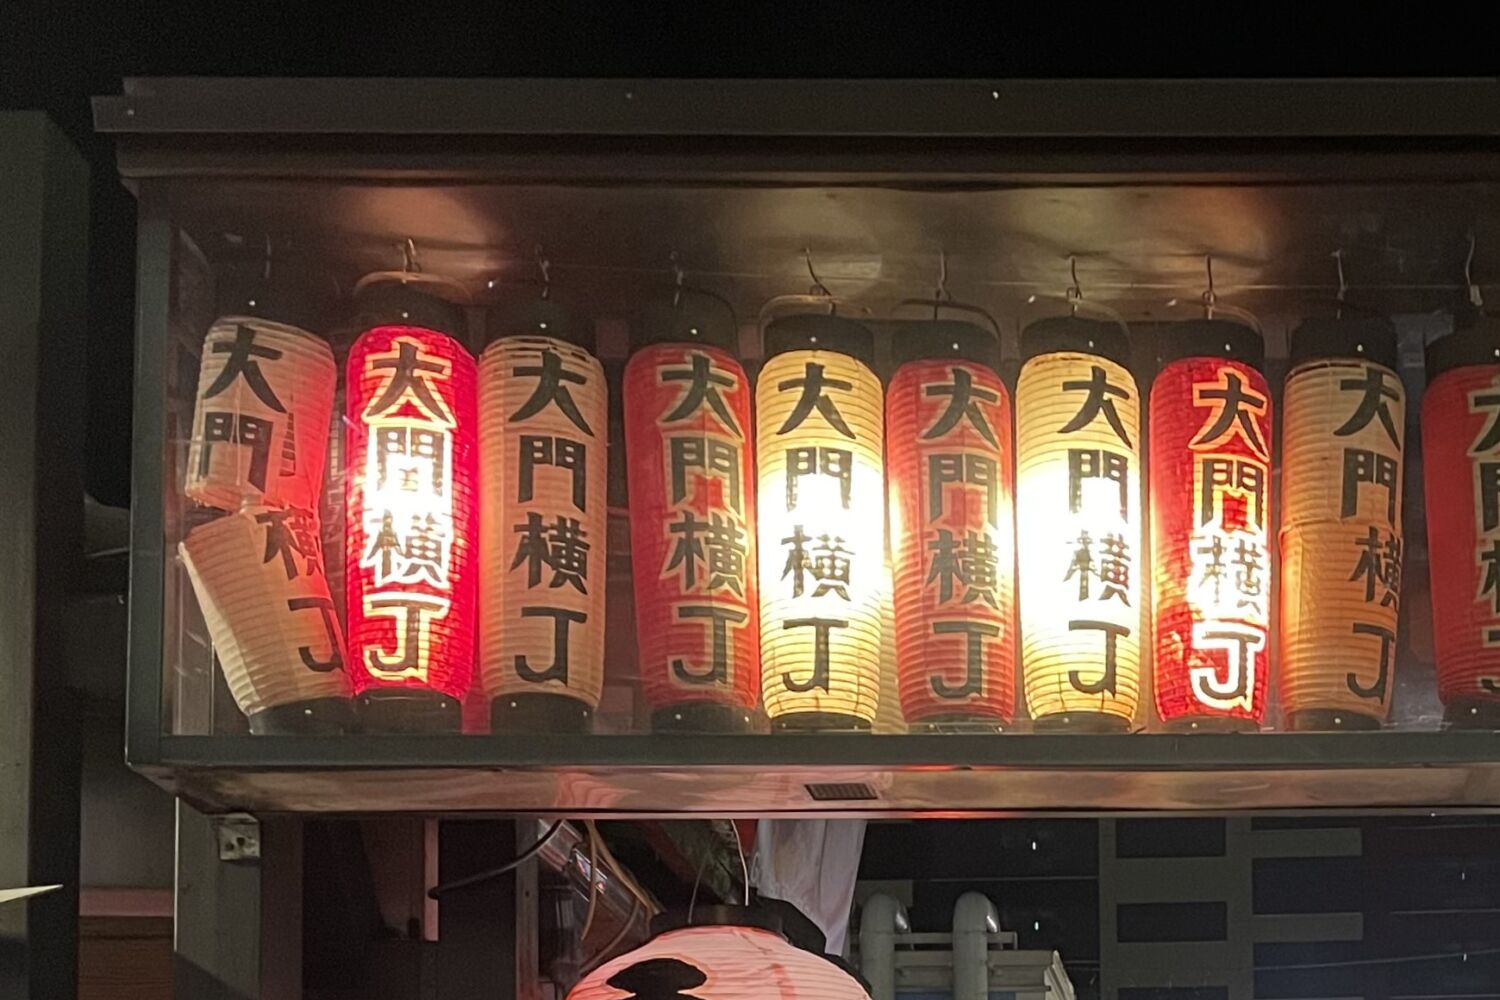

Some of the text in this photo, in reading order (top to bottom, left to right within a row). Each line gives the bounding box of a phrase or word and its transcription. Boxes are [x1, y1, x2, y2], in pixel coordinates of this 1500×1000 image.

[363, 339, 456, 680] 大門横丁
[508, 348, 594, 685] 大門横丁
[659, 353, 744, 685] 大門横丁
[776, 363, 857, 693] 大門横丁
[923, 367, 1001, 699] 大門横丁
[1057, 366, 1133, 697] 大門横丁
[1190, 368, 1272, 708] 大門横丁
[1333, 367, 1403, 704] 大門横丁
